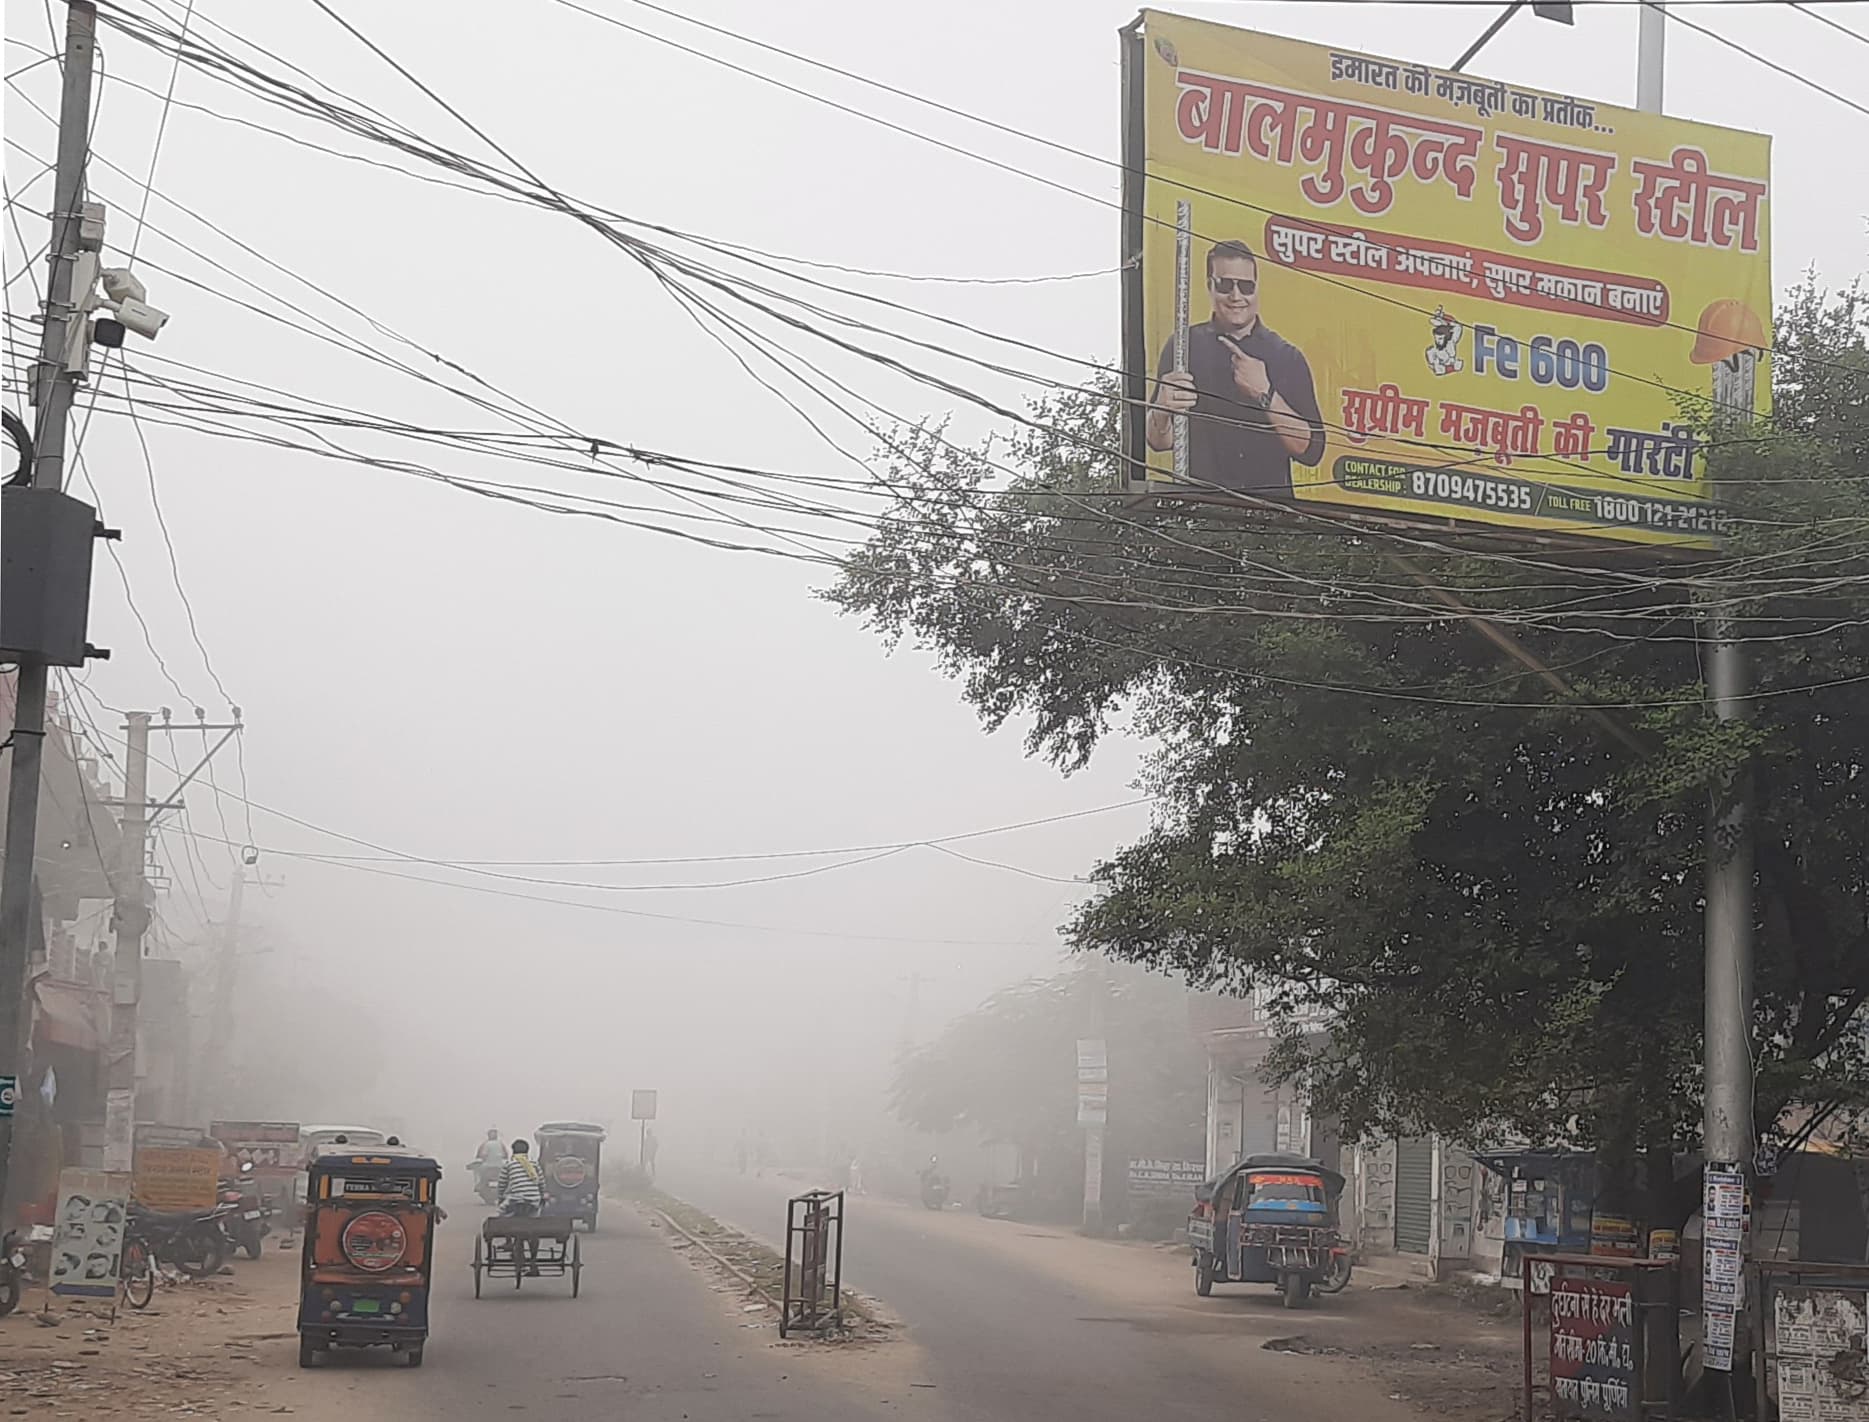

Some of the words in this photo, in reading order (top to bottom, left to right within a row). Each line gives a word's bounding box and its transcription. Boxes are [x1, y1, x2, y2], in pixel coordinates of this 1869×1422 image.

[1330, 52, 1400, 91] इमारत
[1402, 62, 1432, 97] की
[1510, 90, 1538, 120] का
[1175, 69, 1485, 216] बालमुकुन्द
[1494, 133, 1617, 243] सुपर
[1631, 146, 1768, 252] स्टील
[1270, 223, 1327, 264] सुपर
[1327, 231, 1391, 271] स्टील
[1482, 260, 1534, 299] सुपर
[1535, 272, 1605, 307] मकान
[1472, 324, 1521, 381] Fe
[1527, 334, 1609, 393] 600
[1341, 383, 1431, 447] सुप्रीम
[1551, 412, 1596, 463] की
[1605, 421, 1701, 482] गारंटी
[1344, 460, 1388, 477] CONTACT
[1387, 465, 1407, 480] FOR
[1411, 470, 1532, 511] 8709475535
[1547, 494, 1569, 511] TOLL
[1569, 498, 1593, 514] FREE
[1594, 495, 1640, 525] 1800
[1581, 1286, 1591, 1321] से
[1599, 1289, 1612, 1327] देर
[1611, 1291, 1633, 1329] भली
